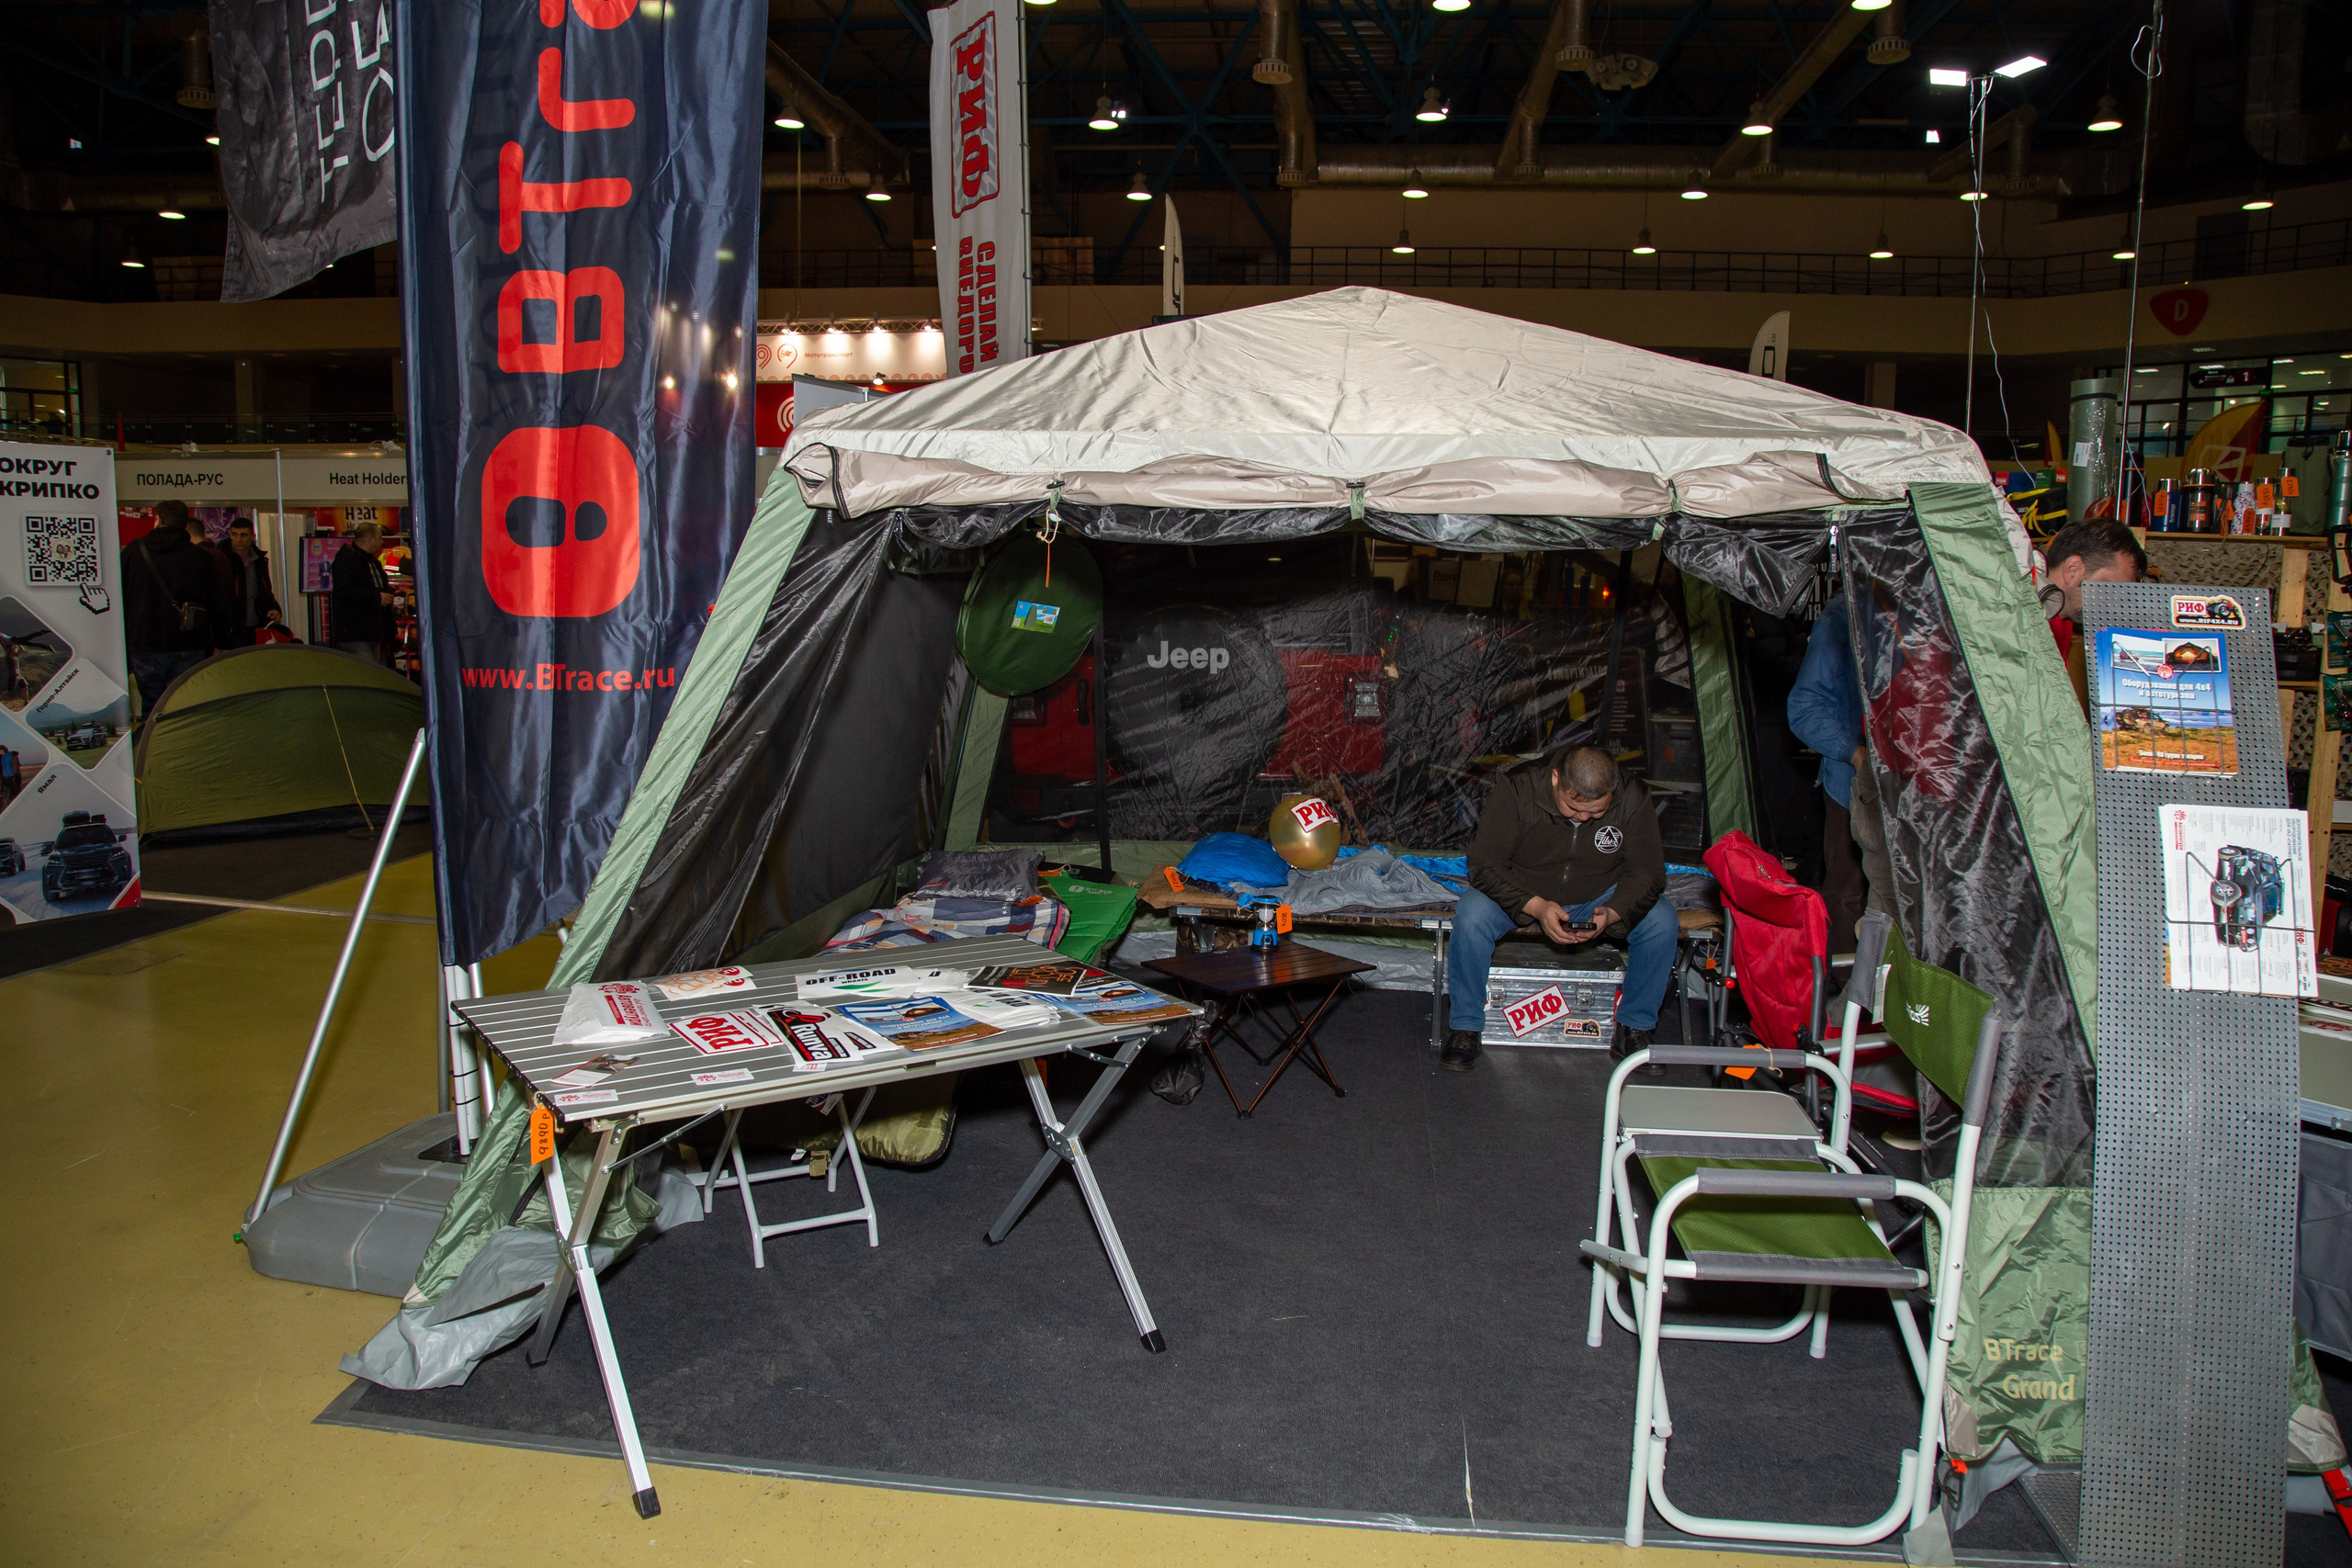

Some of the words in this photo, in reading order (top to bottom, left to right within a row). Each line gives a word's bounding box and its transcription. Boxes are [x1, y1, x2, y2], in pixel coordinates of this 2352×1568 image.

[956, 28, 989, 198] РИФ
[497, 0, 640, 374] BTr
[976, 242, 998, 362] СДЕЛАЙ
[2174, 299, 2188, 321] D
[0, 457, 78, 476] ОКРУГ
[137, 473, 224, 487] ПОЛАДА-РУС
[329, 472, 359, 485] Heat
[362, 472, 409, 485] Holder
[0, 480, 100, 499] КРИПКО
[2177, 602, 2204, 613] РИФ
[1147, 640, 1229, 674] Jeep
[36, 668, 80, 714] Горно-Алтайск
[461, 663, 676, 692] www.BTrace.ru
[37, 773, 58, 795] Ямал
[805, 968, 897, 986] OFF-ROAD
[1508, 993, 1562, 1032] РИФ
[686, 1016, 754, 1050] РИФ
[790, 1023, 833, 1060] Runva
[1983, 1337, 2064, 1363] BTrace
[2002, 1373, 2075, 1401] Grand
